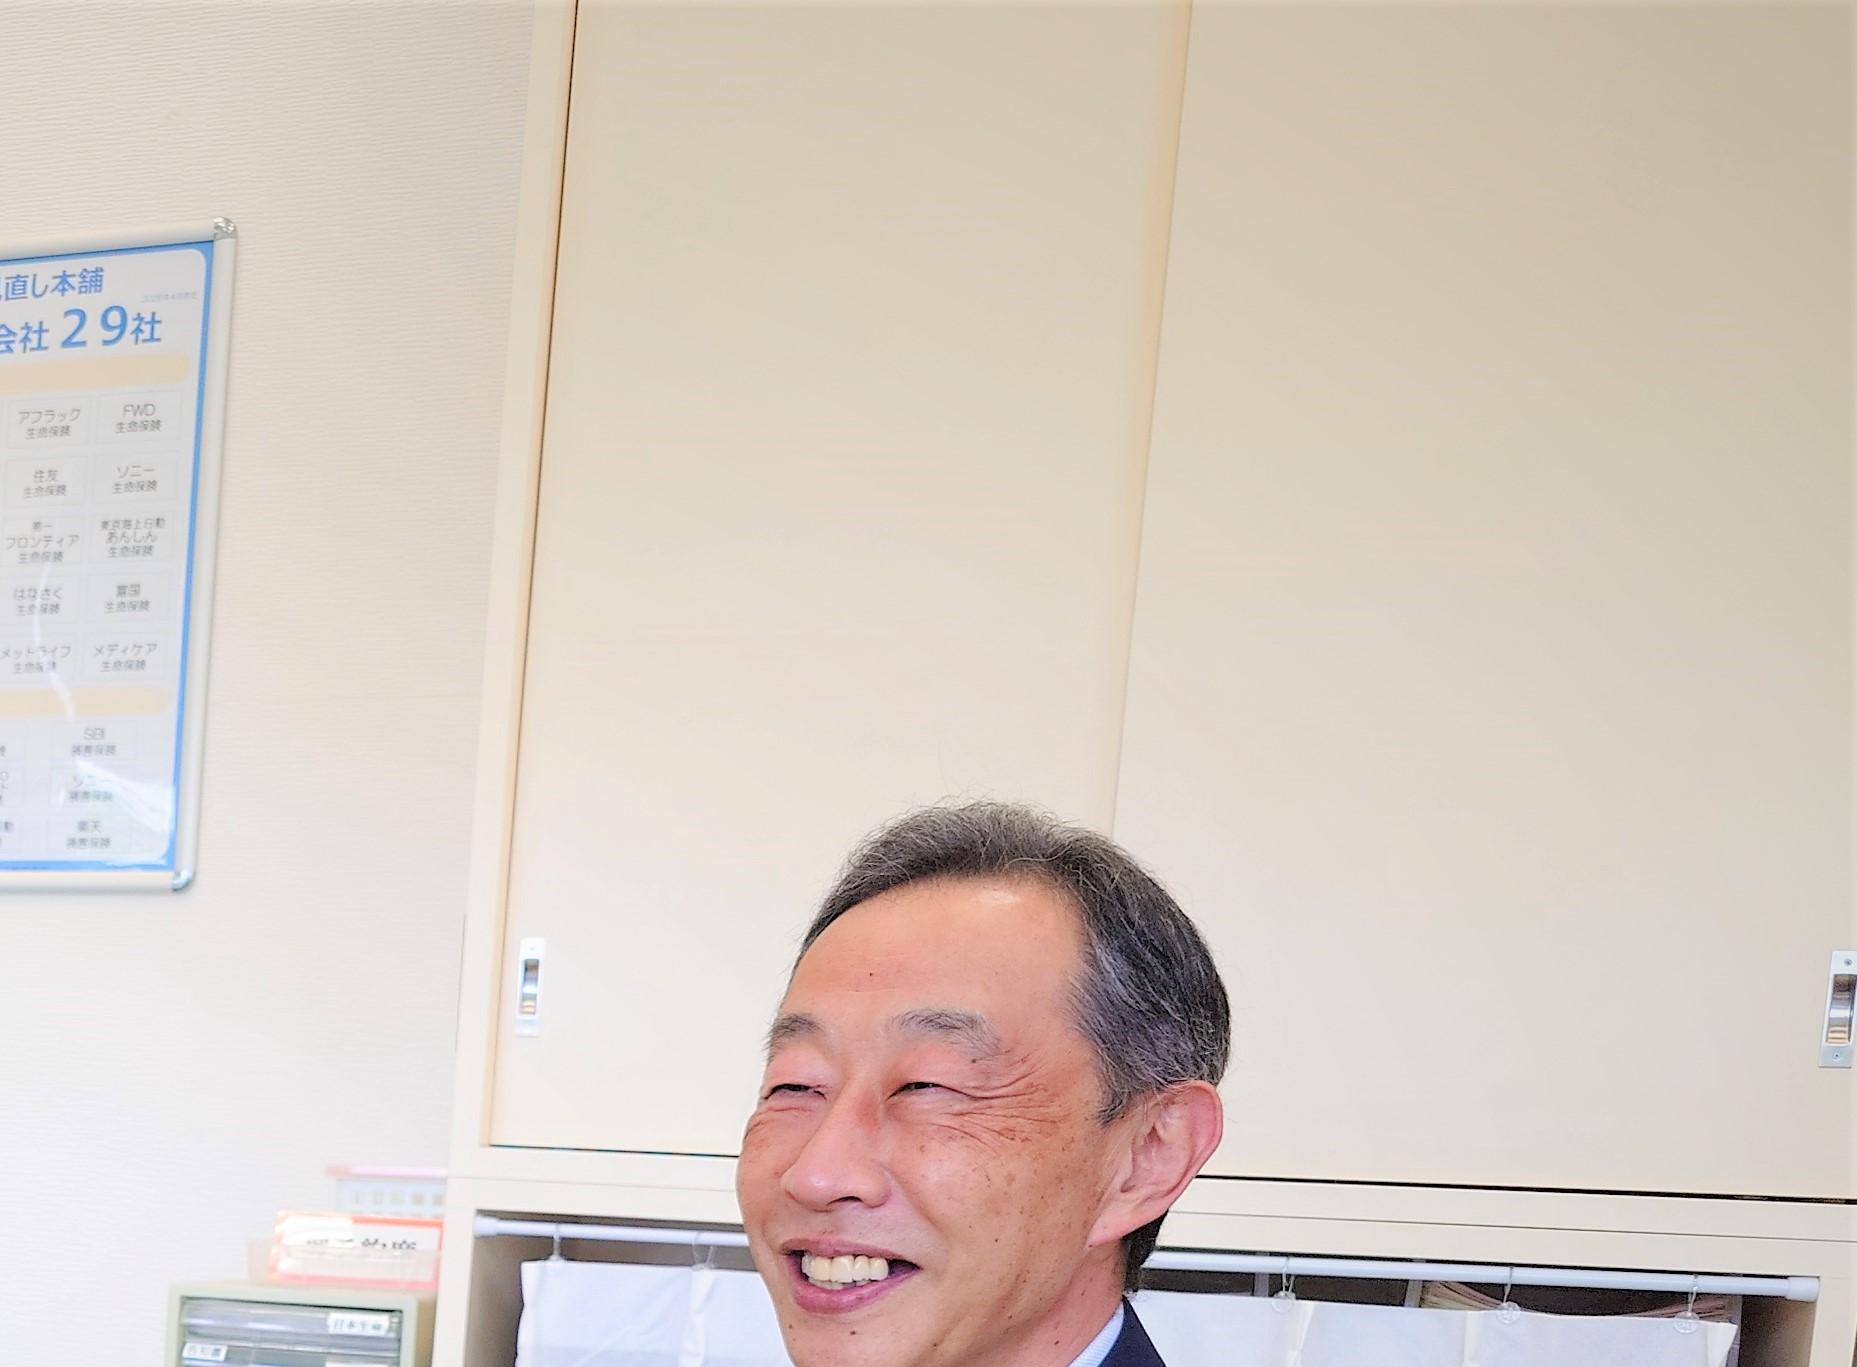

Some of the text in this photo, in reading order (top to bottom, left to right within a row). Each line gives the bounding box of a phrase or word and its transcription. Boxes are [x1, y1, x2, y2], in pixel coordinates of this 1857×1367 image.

[18, 408, 81, 424] アフラック
[123, 403, 156, 417] FWD
[117, 465, 154, 478] ソニー
